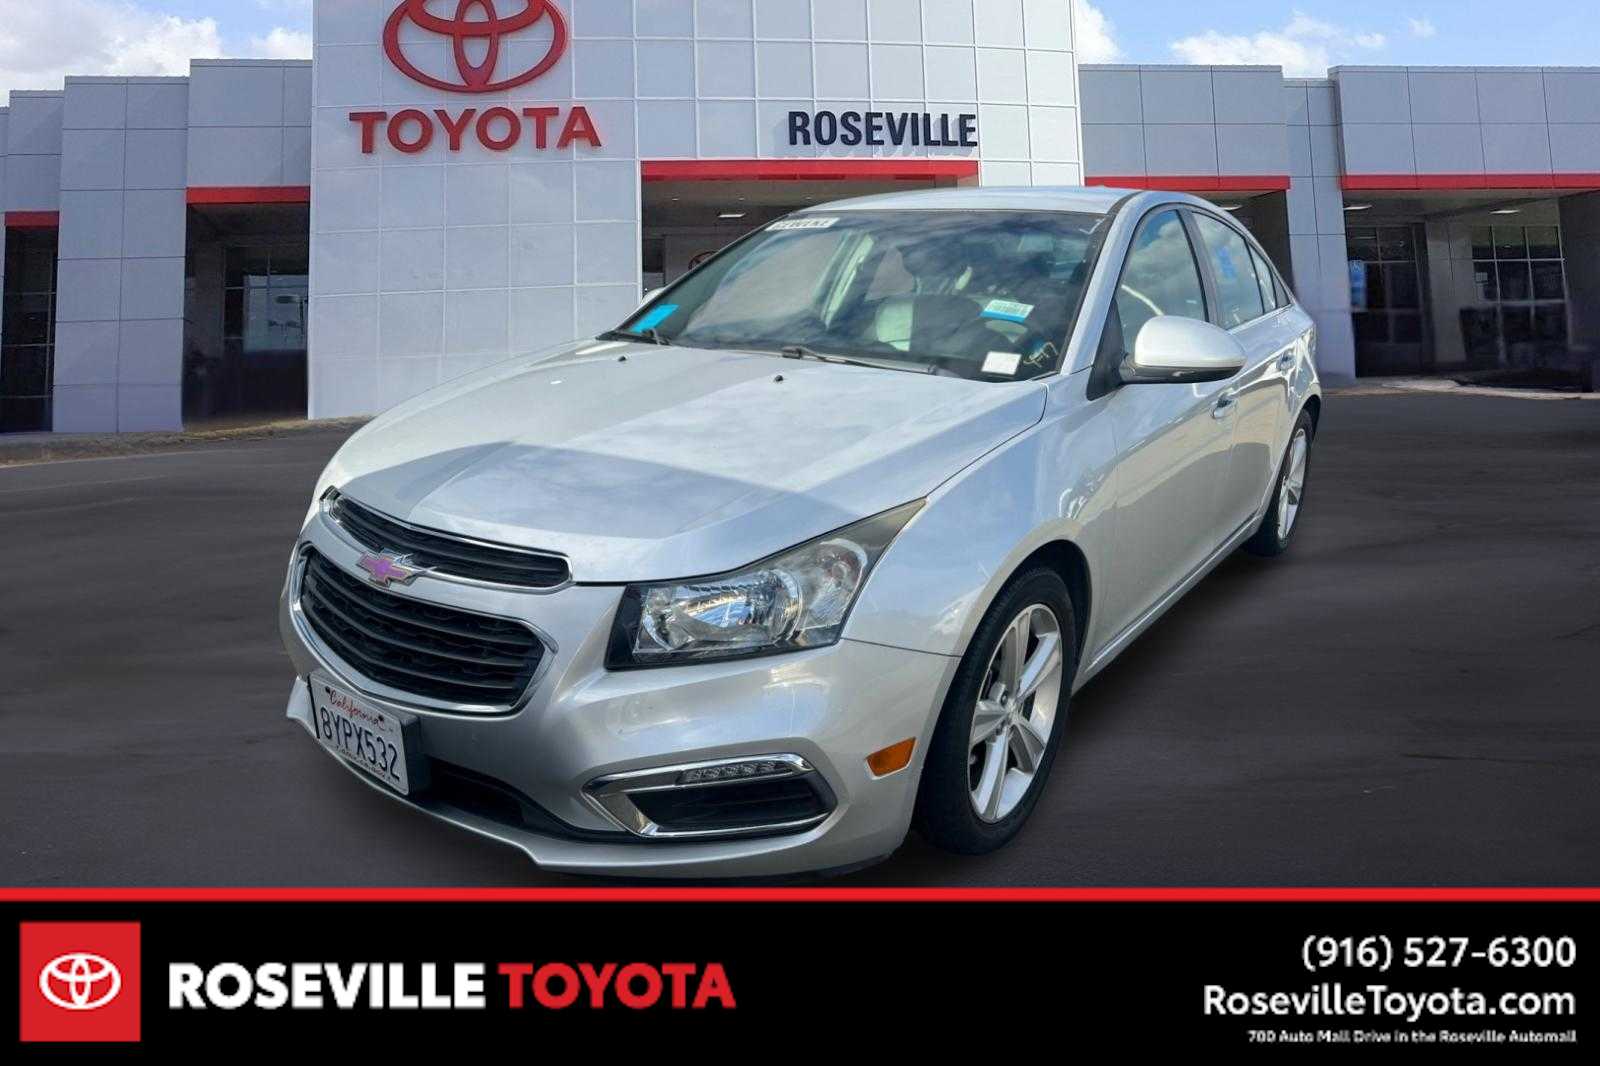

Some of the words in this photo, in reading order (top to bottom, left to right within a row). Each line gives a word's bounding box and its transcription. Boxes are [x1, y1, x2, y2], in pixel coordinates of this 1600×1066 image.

[349, 106, 602, 154] TOYOTA
[788, 110, 978, 147] ROSEVILLE
[330, 689, 385, 729] California
[321, 706, 401, 780] 8YPX532
